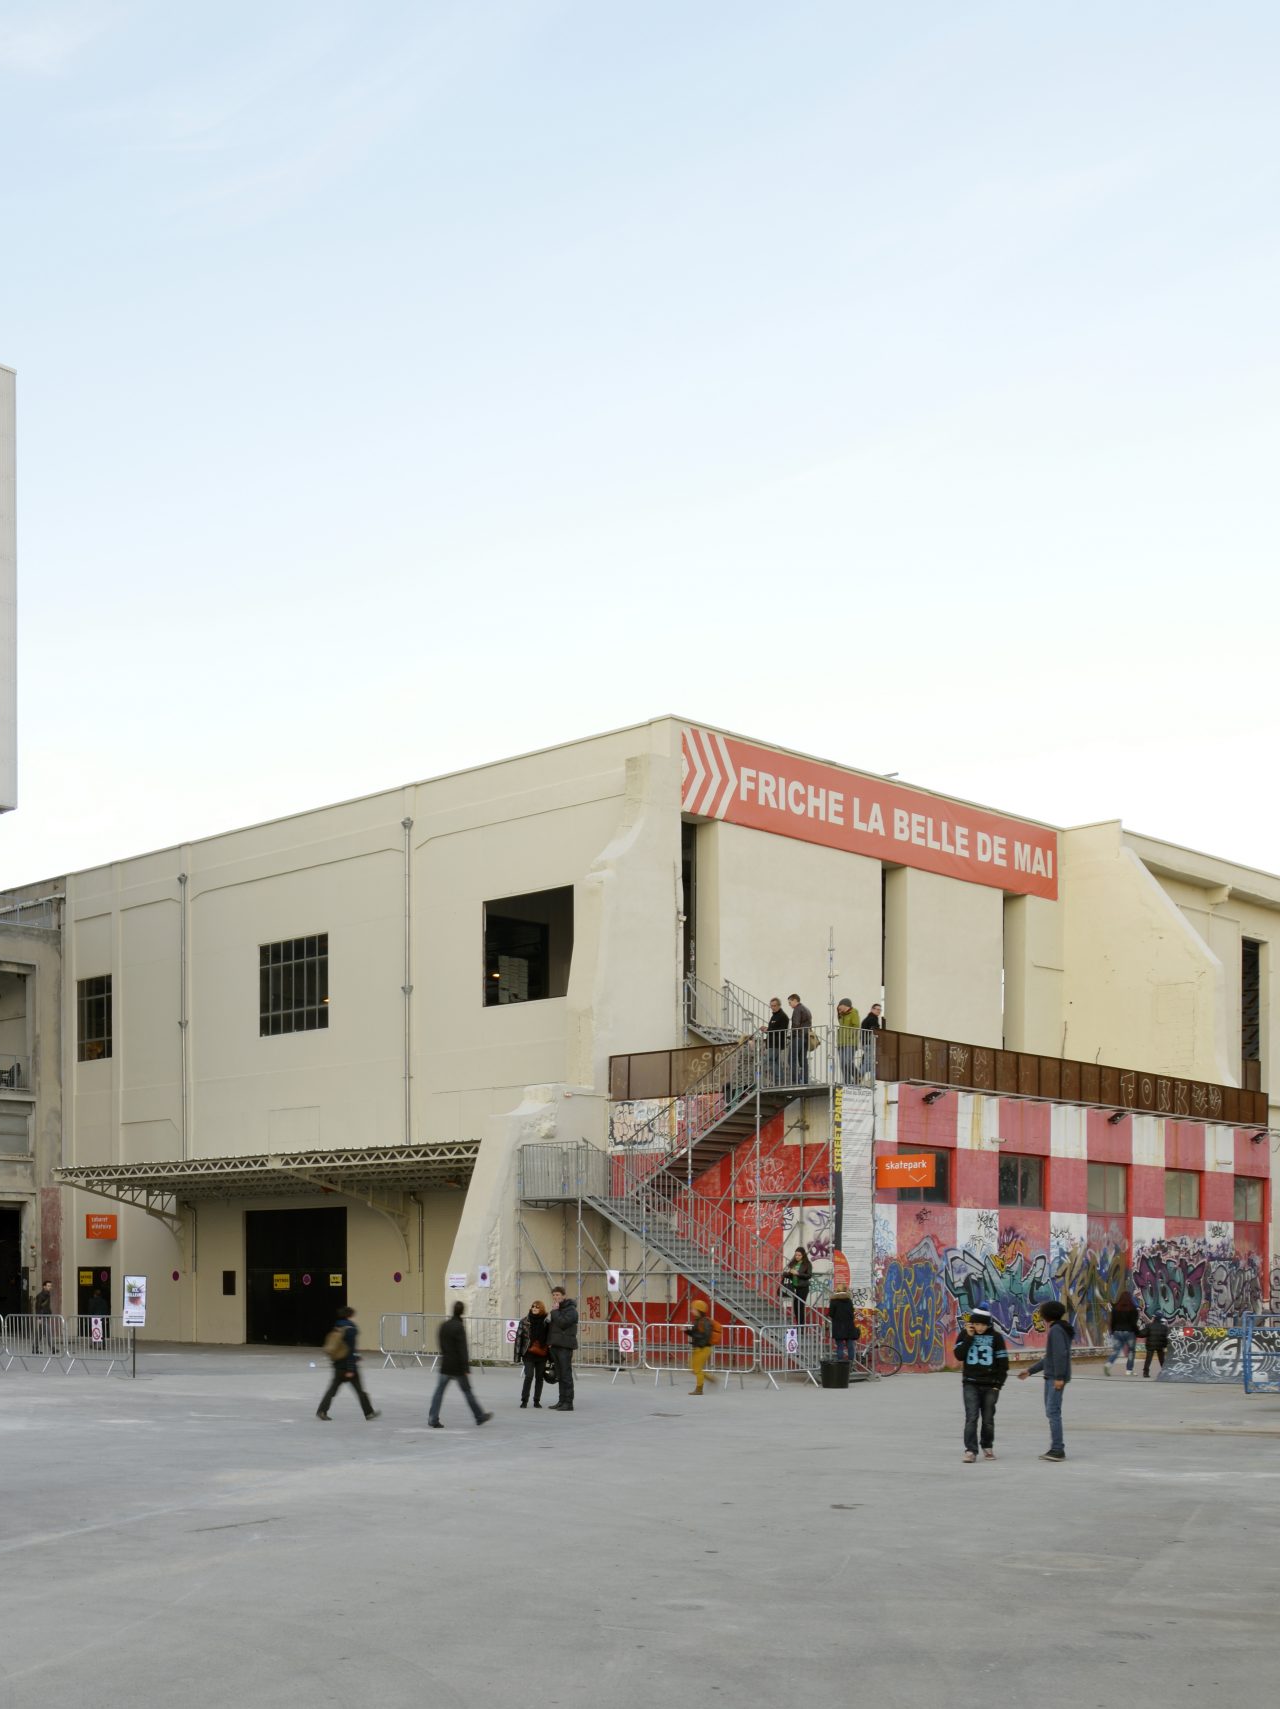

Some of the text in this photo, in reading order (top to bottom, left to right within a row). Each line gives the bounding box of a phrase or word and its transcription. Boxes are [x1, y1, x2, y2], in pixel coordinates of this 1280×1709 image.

[740, 767, 1052, 879] FRICHE LA BELLE DE MAI
[834, 1087, 843, 1172] STREET PARK
[885, 1160, 927, 1171] skatepark
[966, 1345, 993, 1366] 83
